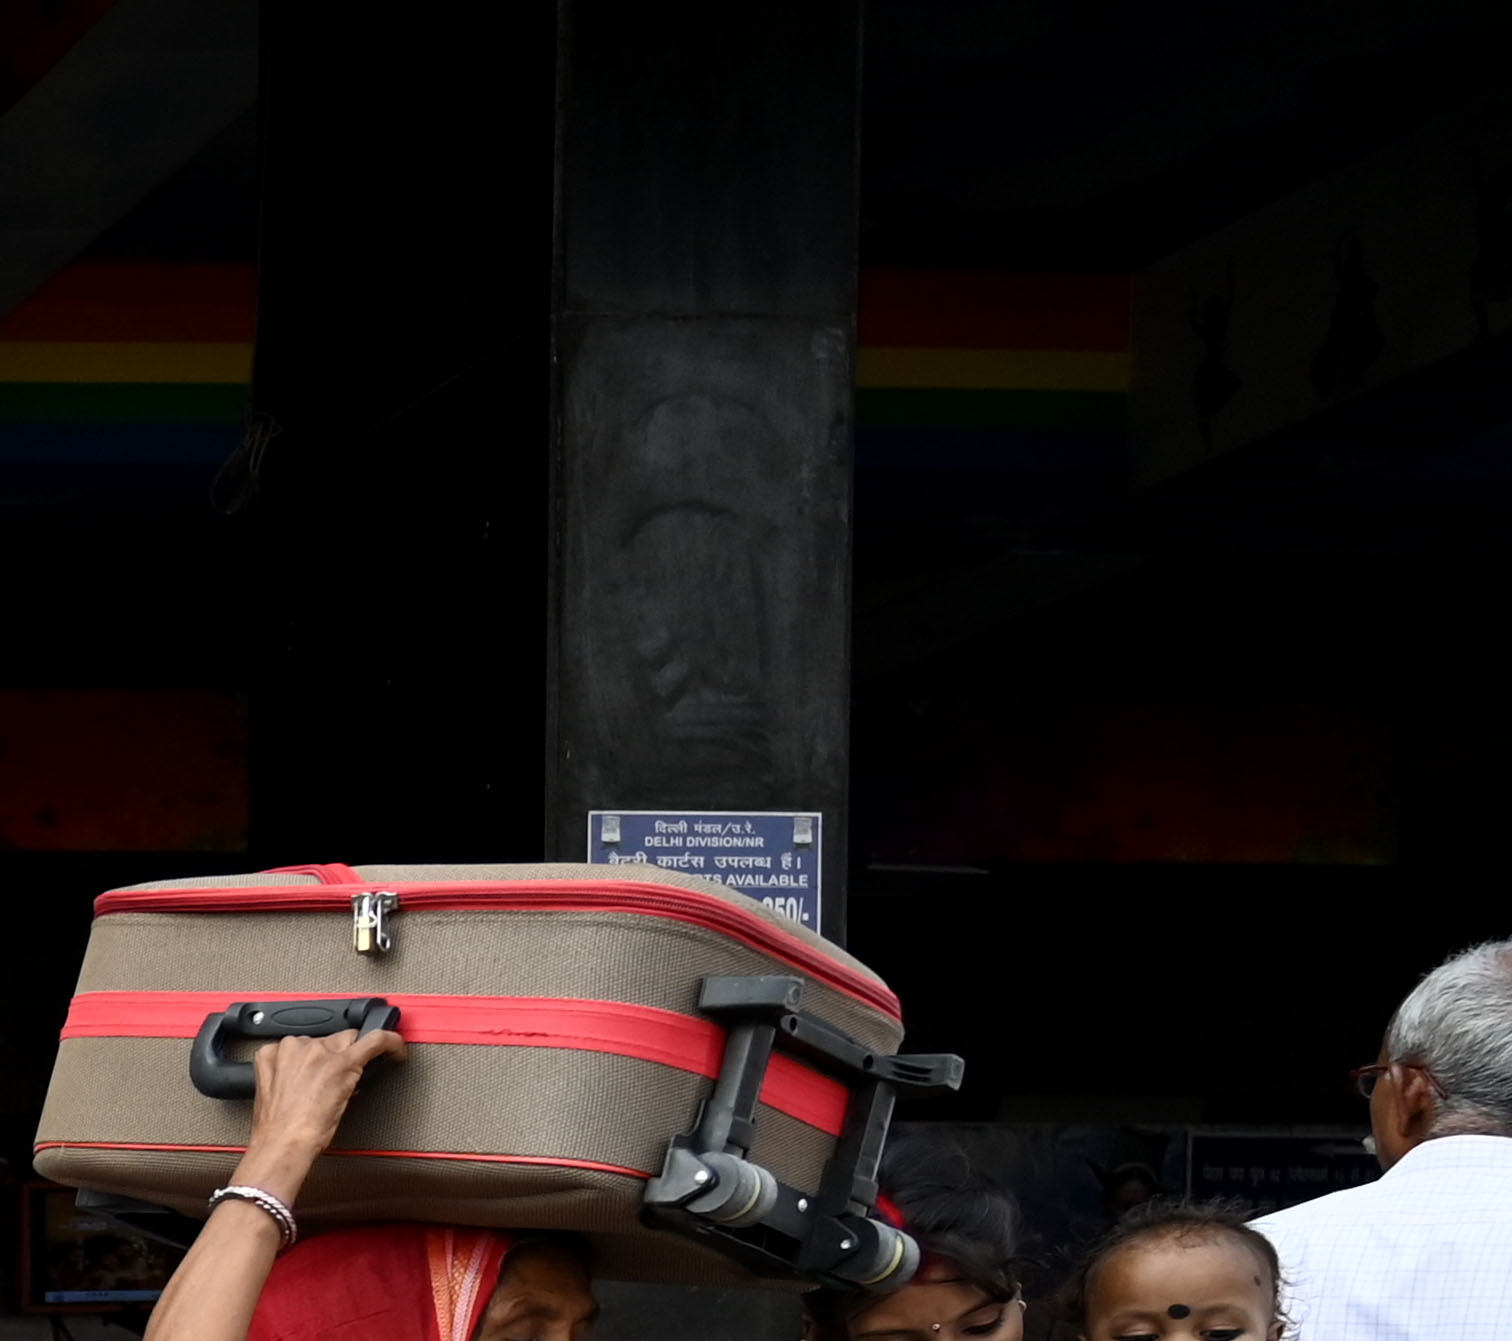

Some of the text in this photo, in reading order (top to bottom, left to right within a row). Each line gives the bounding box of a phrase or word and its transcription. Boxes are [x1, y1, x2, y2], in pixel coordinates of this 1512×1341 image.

[654, 820, 688, 834] दिल्ली
[644, 837, 764, 849] DELHI DIVISION/NR
[725, 873, 809, 888] AVAILABLE
